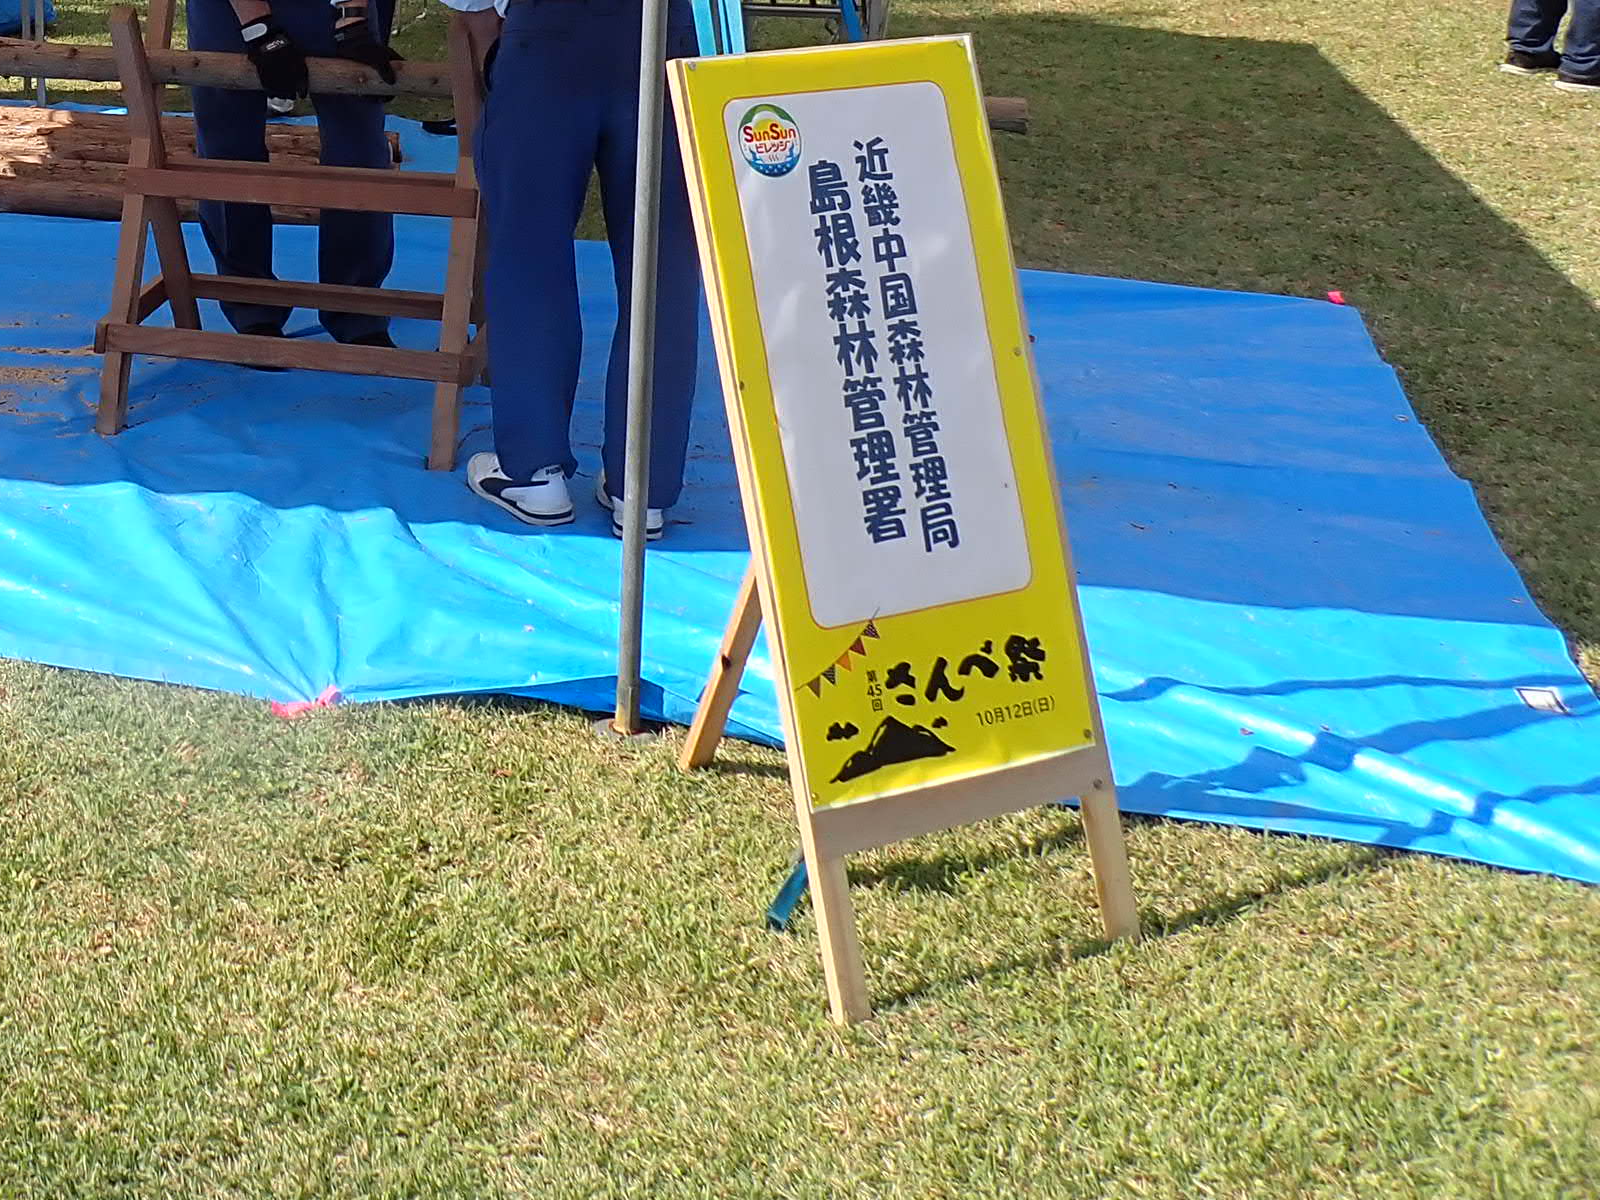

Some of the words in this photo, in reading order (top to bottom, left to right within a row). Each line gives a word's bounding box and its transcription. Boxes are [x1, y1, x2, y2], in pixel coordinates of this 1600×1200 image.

[743, 123, 797, 143] SunSun
[755, 140, 791, 154] ビレッジ
[807, 159, 907, 544] 島根森林管理署
[853, 137, 960, 552] 近畿中国森林管理局
[885, 634, 1046, 706] さんべ祭
